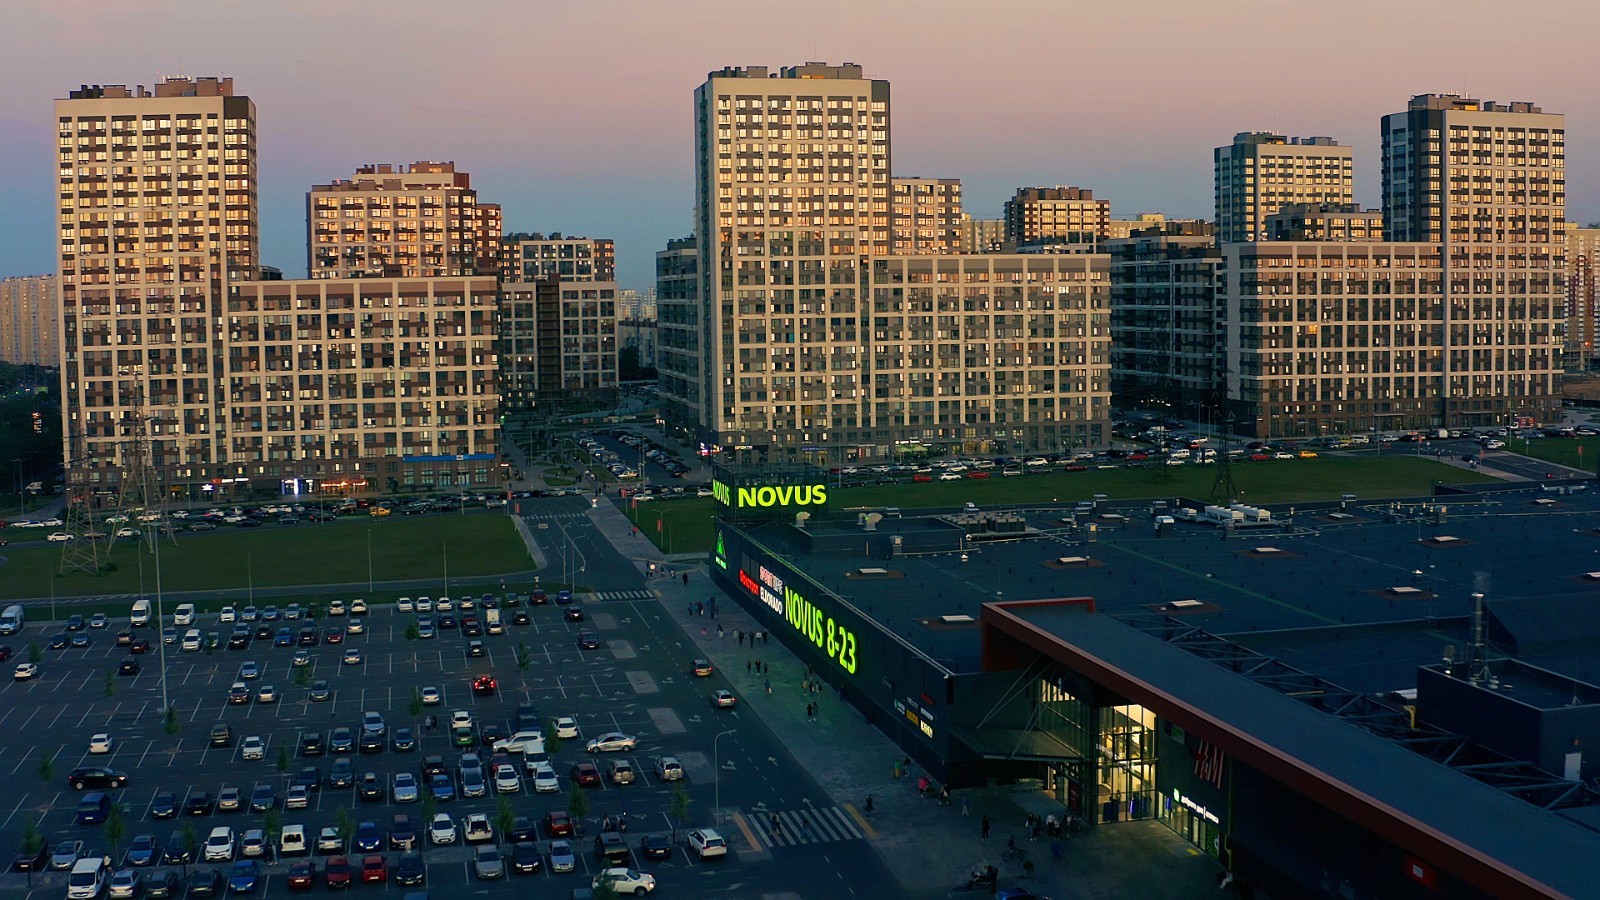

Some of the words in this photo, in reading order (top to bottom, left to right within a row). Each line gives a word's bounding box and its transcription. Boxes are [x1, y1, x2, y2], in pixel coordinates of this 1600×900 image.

[738, 484, 827, 508] NOVUS
[785, 586, 824, 649] NOVUS
[827, 617, 858, 675] 8-23
